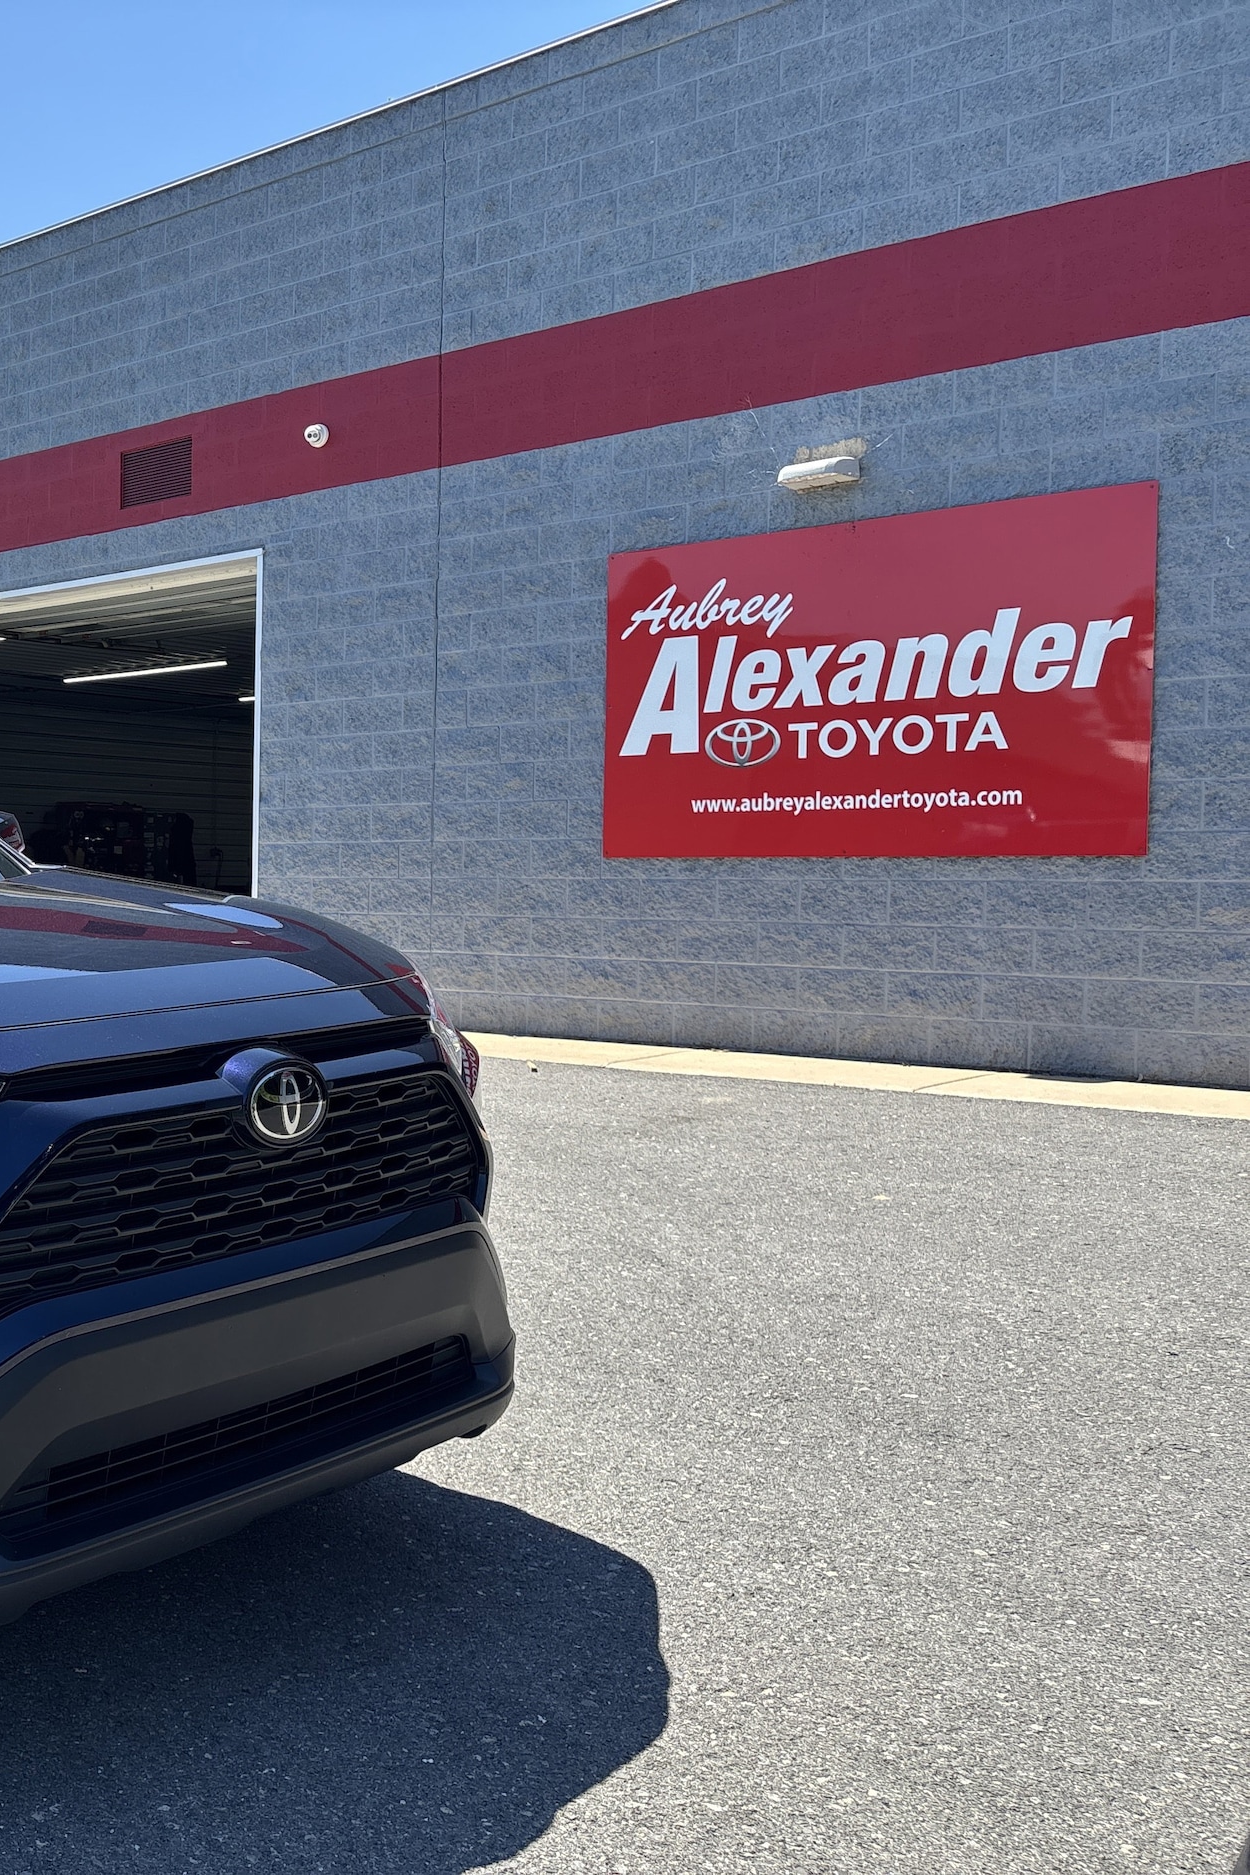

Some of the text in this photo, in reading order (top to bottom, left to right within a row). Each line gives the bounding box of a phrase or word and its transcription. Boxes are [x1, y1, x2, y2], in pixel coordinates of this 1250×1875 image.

[621, 578, 793, 640] Aubrey
[619, 607, 1133, 757] Alexander
[787, 711, 1010, 759] TOYOTA
[691, 788, 1023, 816] www.aubreyalexandertoyota.com
